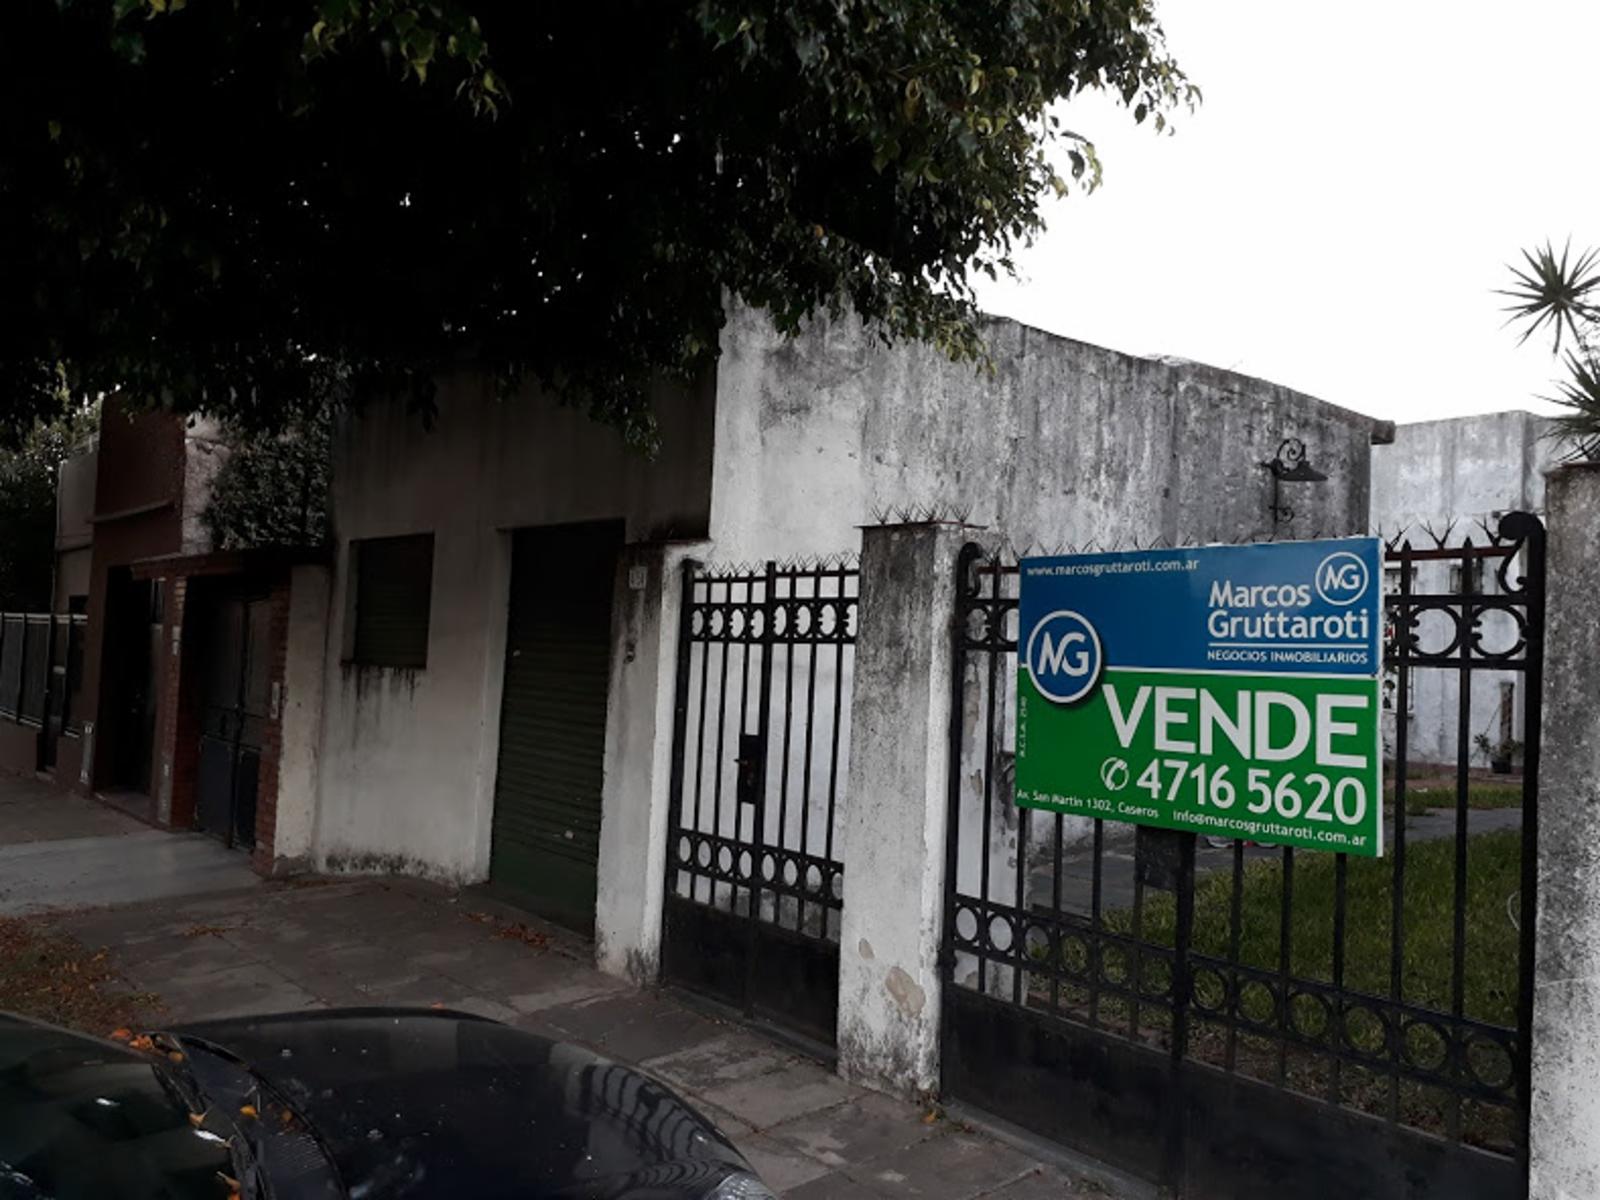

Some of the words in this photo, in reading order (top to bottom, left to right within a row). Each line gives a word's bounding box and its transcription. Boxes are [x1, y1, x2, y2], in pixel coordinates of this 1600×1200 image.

[1026, 559, 1200, 577] www.marcosgruttaroti.com.ar
[1208, 580, 1312, 608] Marcos
[1207, 608, 1369, 639] Gruttaroti
[1207, 649, 1268, 663] NEGOCIOS
[1270, 651, 1369, 665] INMOBILIARIOS
[1102, 683, 1369, 769] VENDE
[1032, 790, 1050, 802] San
[1117, 801, 1160, 819] Caseros
[1136, 758, 1236, 809] 4716
[1247, 768, 1367, 825] 5620
[1172, 809, 1367, 847] info@marcosgruttaroti.com.ar
